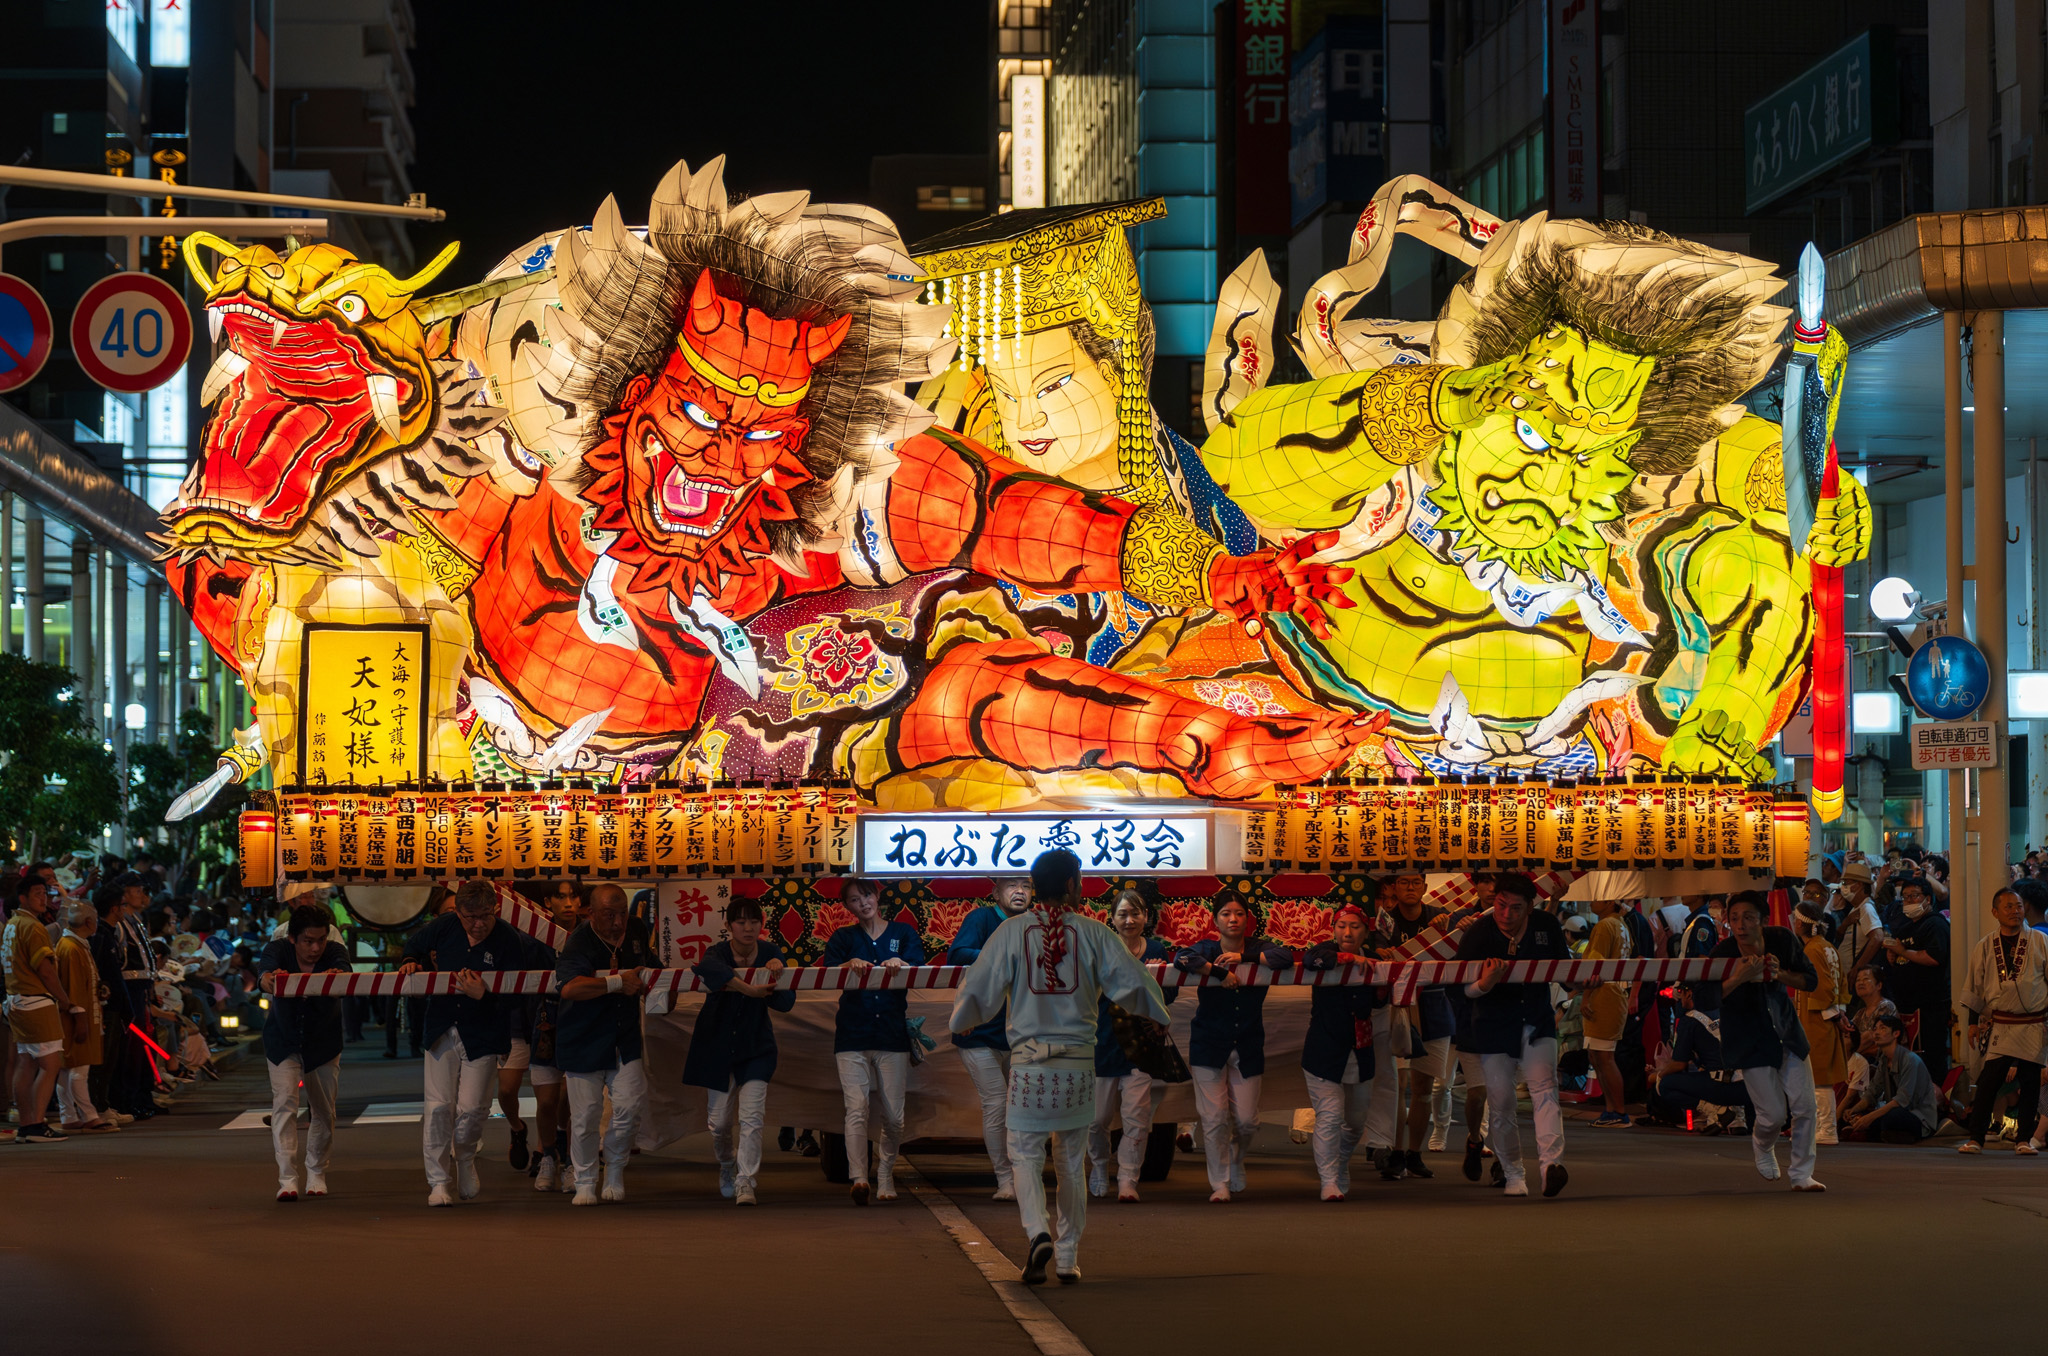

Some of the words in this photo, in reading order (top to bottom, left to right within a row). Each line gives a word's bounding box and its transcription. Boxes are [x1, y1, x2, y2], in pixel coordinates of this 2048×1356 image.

[1752, 55, 1862, 187] みちのく銀行
[100, 308, 163, 358] 40
[341, 656, 382, 769] 天妃様
[389, 642, 410, 767] 大海の守護神
[1918, 727, 1989, 744] 自転車通行可
[1919, 746, 1990, 763] 歩行者優先
[309, 799, 329, 866] (有)小野設備
[366, 800, 389, 866] (株)三浩保温
[425, 797, 437, 864] MOTORS
[438, 797, 449, 834] ZERO
[454, 797, 474, 864] スマホなおし太郎
[482, 796, 502, 863] オレンジ
[541, 794, 564, 862] (有)山田工務店
[569, 794, 589, 860] 村上建装
[654, 793, 676, 860] (株)フカガワ
[727, 794, 736, 861] ライトブルー
[757, 793, 765, 860] ライトブルー
[800, 791, 824, 859] ライトブルー
[831, 793, 850, 861] ライトブルー
[1304, 791, 1324, 858] 朴子配天宮
[1331, 790, 1350, 857] 東石小木屋
[1526, 787, 1536, 854] GARDEN
[1537, 787, 1546, 820] DOG
[1604, 789, 1623, 854] (株)東京商事
[1752, 796, 1772, 862] 八甲法律事務所
[437, 837, 449, 864] ONE
[885, 819, 1185, 868] ねぶた愛好会
[674, 888, 713, 966] 許可
